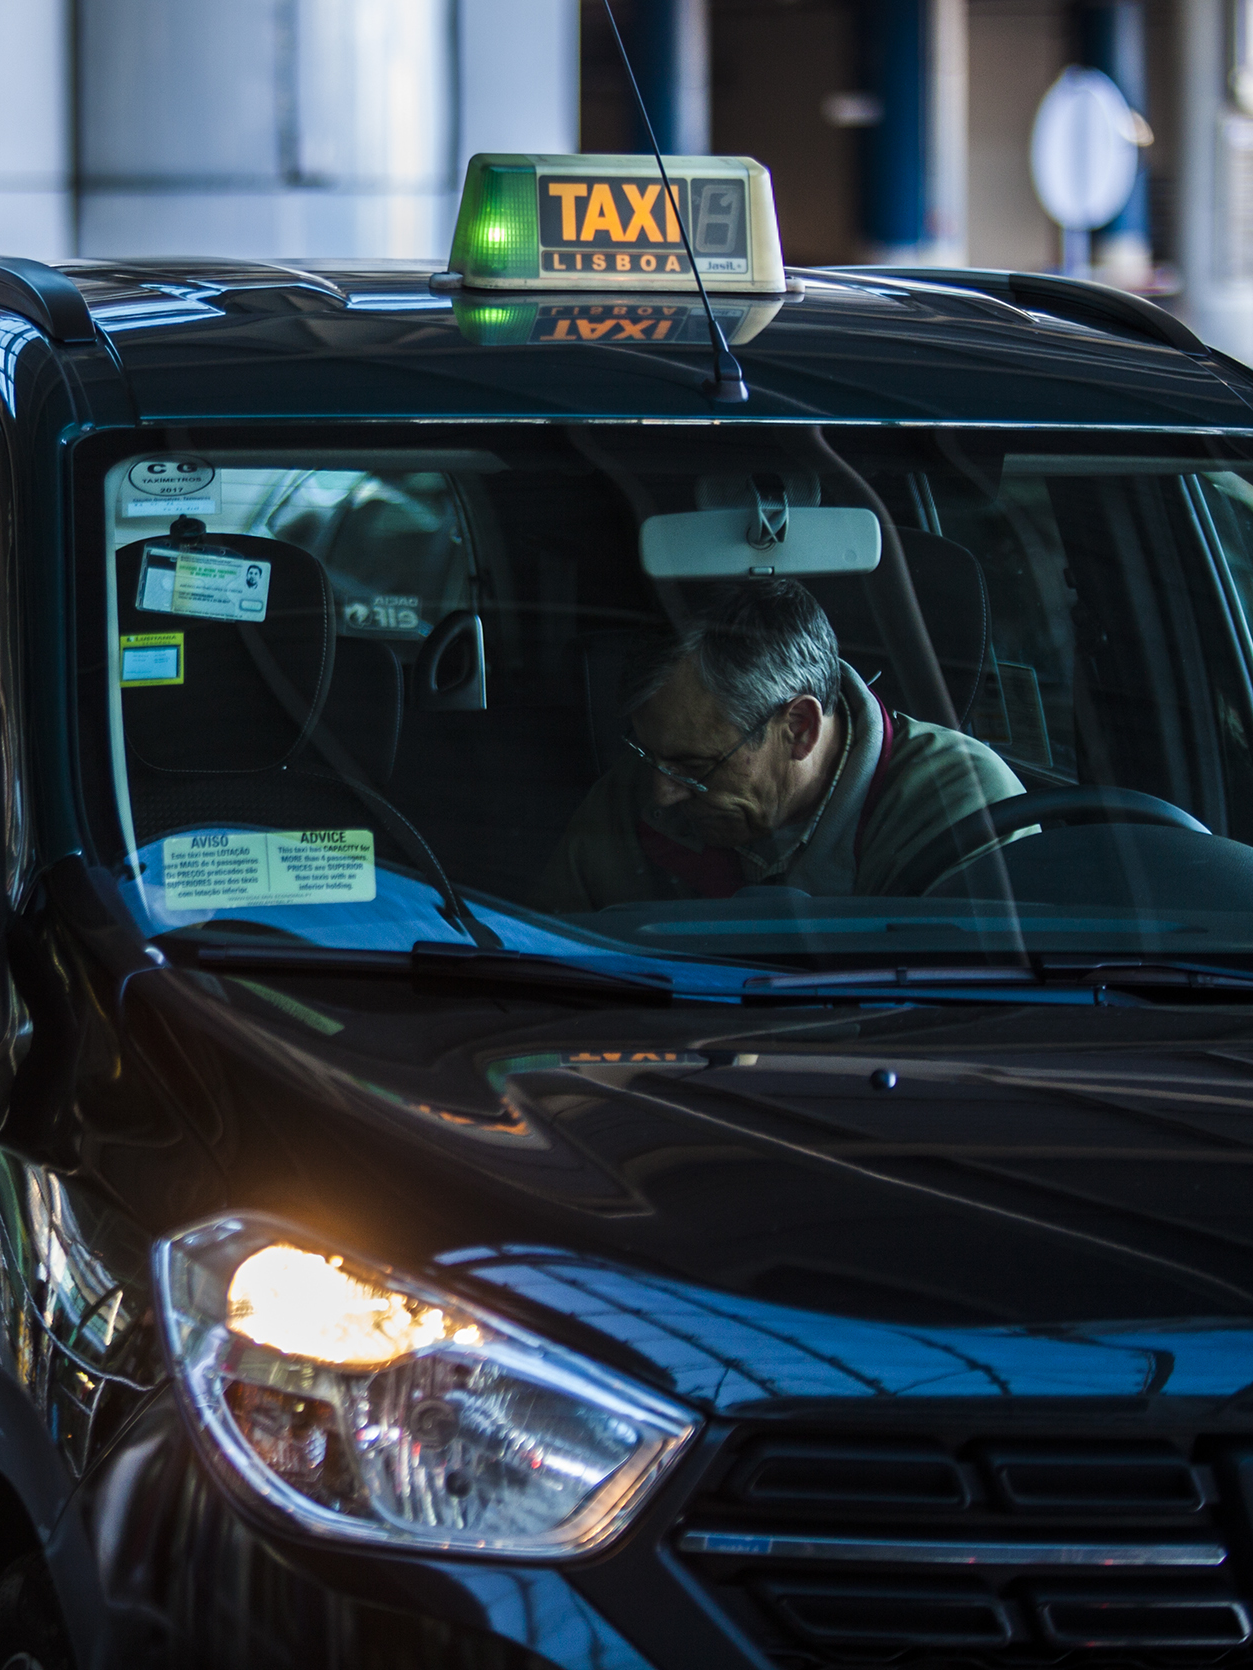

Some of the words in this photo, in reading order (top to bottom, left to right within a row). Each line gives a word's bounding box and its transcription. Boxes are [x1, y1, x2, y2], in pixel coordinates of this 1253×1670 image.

[548, 182, 684, 243] TAXI
[553, 253, 682, 273] LISBOA
[147, 463, 167, 475] C
[190, 836, 229, 849] AVISO
[300, 831, 347, 844] ADVICE
[323, 844, 359, 853] CAPACITY
[179, 860, 200, 869] MAIS
[287, 864, 313, 872] PRICES
[327, 863, 364, 871] SUPERIOR
